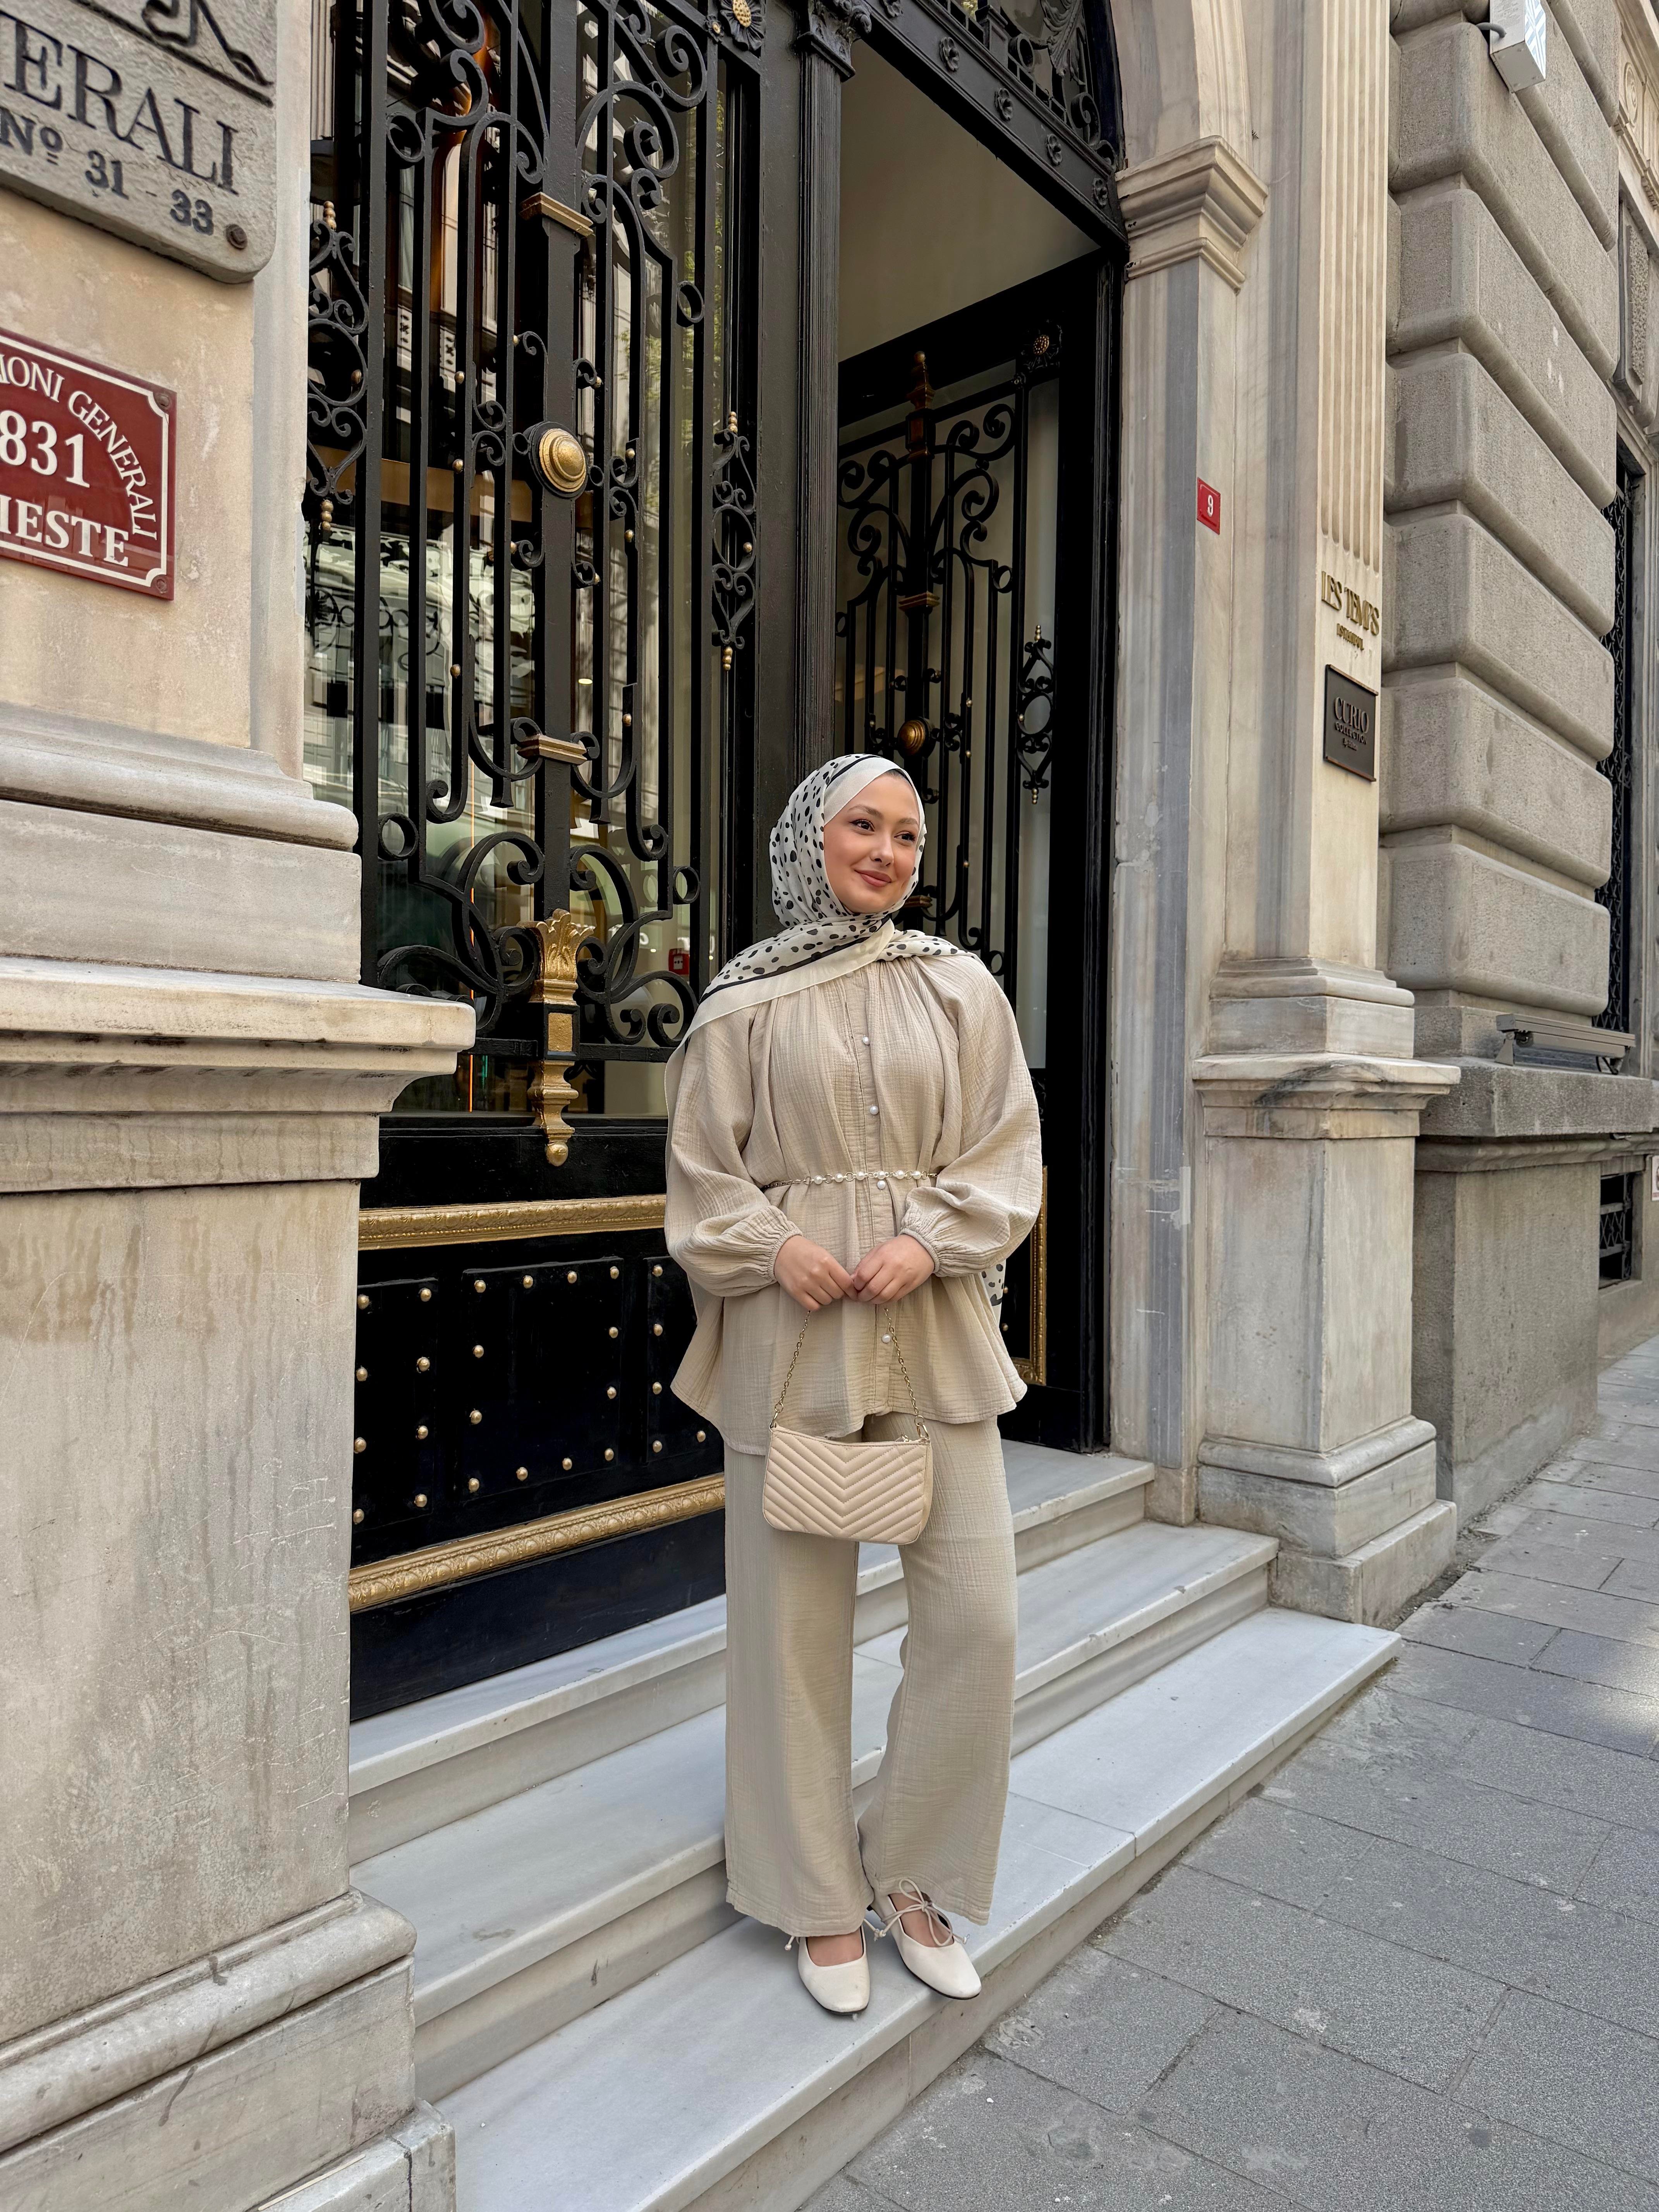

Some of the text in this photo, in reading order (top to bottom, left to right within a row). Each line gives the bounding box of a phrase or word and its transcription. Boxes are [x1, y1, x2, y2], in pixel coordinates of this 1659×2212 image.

[0, 10, 239, 195] ERALI
[85, 151, 129, 199] 31
[170, 189, 214, 235] 33
[0, 354, 157, 540] IONI GENERALI
[0, 410, 90, 488] 831
[1207, 495, 1213, 517] 9
[1321, 571, 1379, 635] LES TEMPS
[1334, 697, 1369, 733] CURIO
